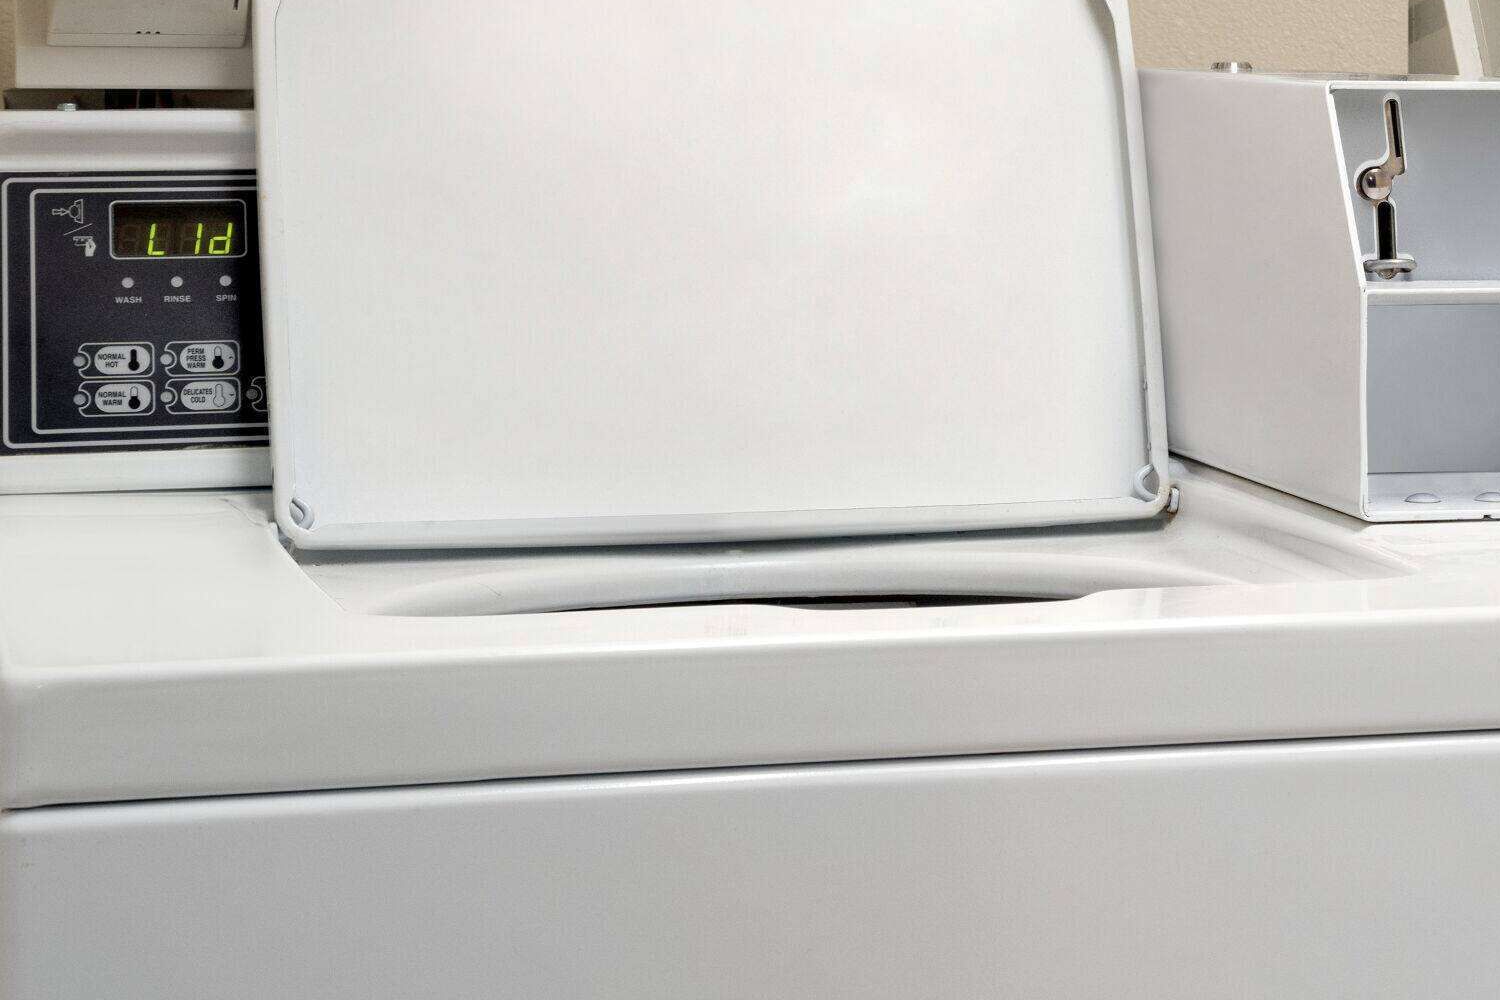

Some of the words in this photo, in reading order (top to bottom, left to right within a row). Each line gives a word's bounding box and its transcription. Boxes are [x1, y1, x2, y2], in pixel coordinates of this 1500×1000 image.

[115, 296, 143, 304] WASH
[164, 295, 192, 303] RINSE
[215, 294, 237, 302] SPIN
[97, 353, 127, 361] NORMAL
[98, 391, 127, 399] NORMAL
[183, 388, 213, 396] DELICATES
[190, 396, 206, 404] COLD
